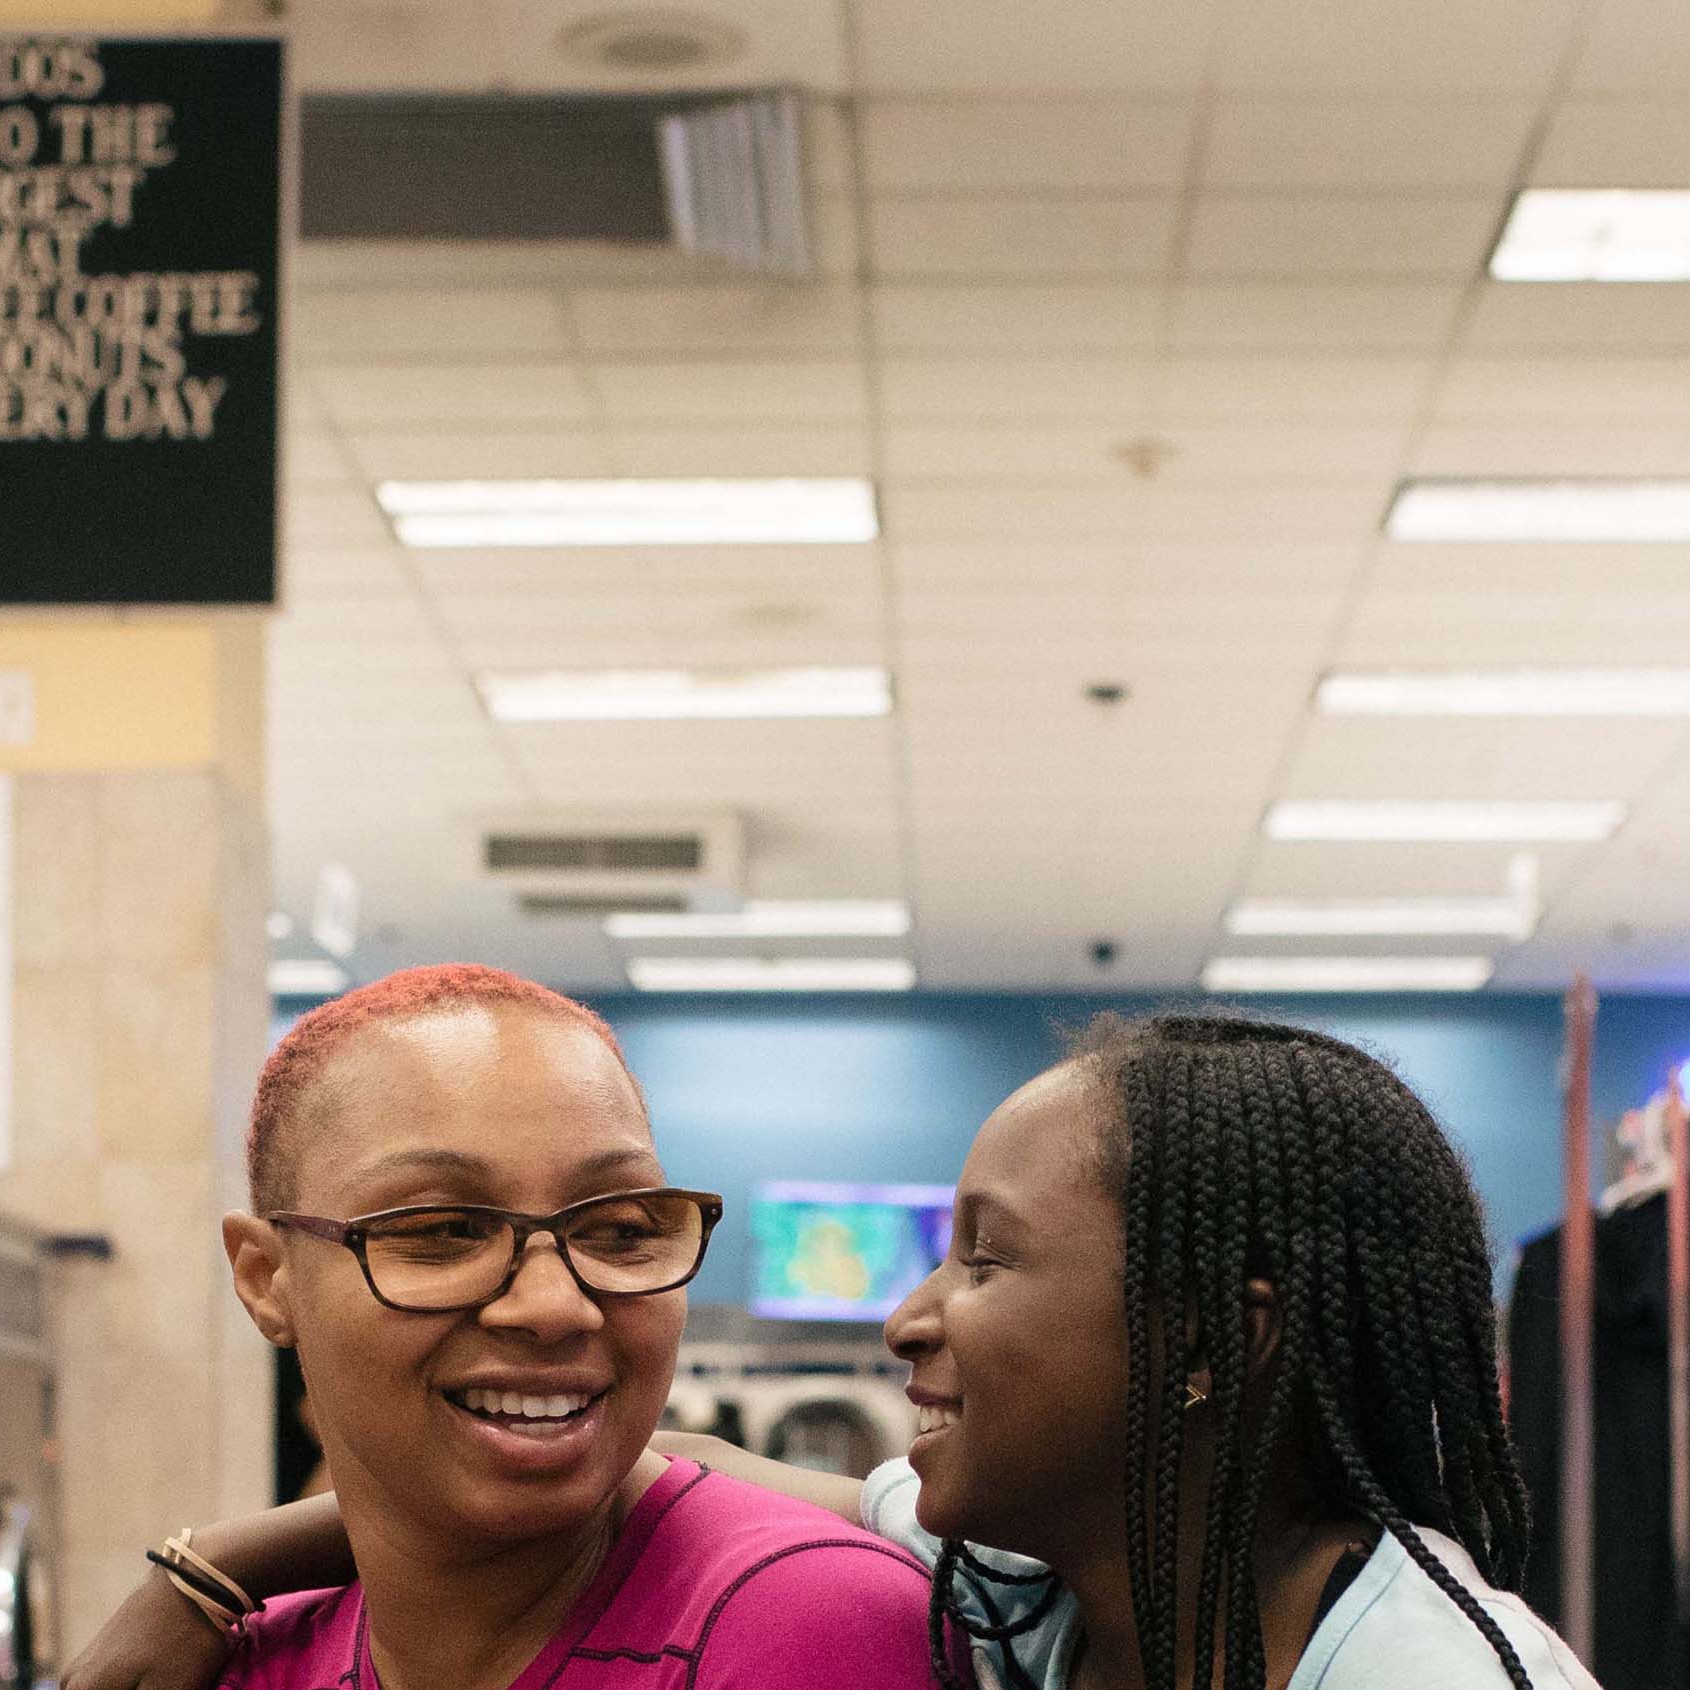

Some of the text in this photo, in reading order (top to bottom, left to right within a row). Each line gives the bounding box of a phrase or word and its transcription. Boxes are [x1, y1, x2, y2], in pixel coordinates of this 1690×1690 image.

[50, 103, 177, 167] THE
[57, 270, 262, 336] COFFEE
[103, 374, 227, 441] DAY
